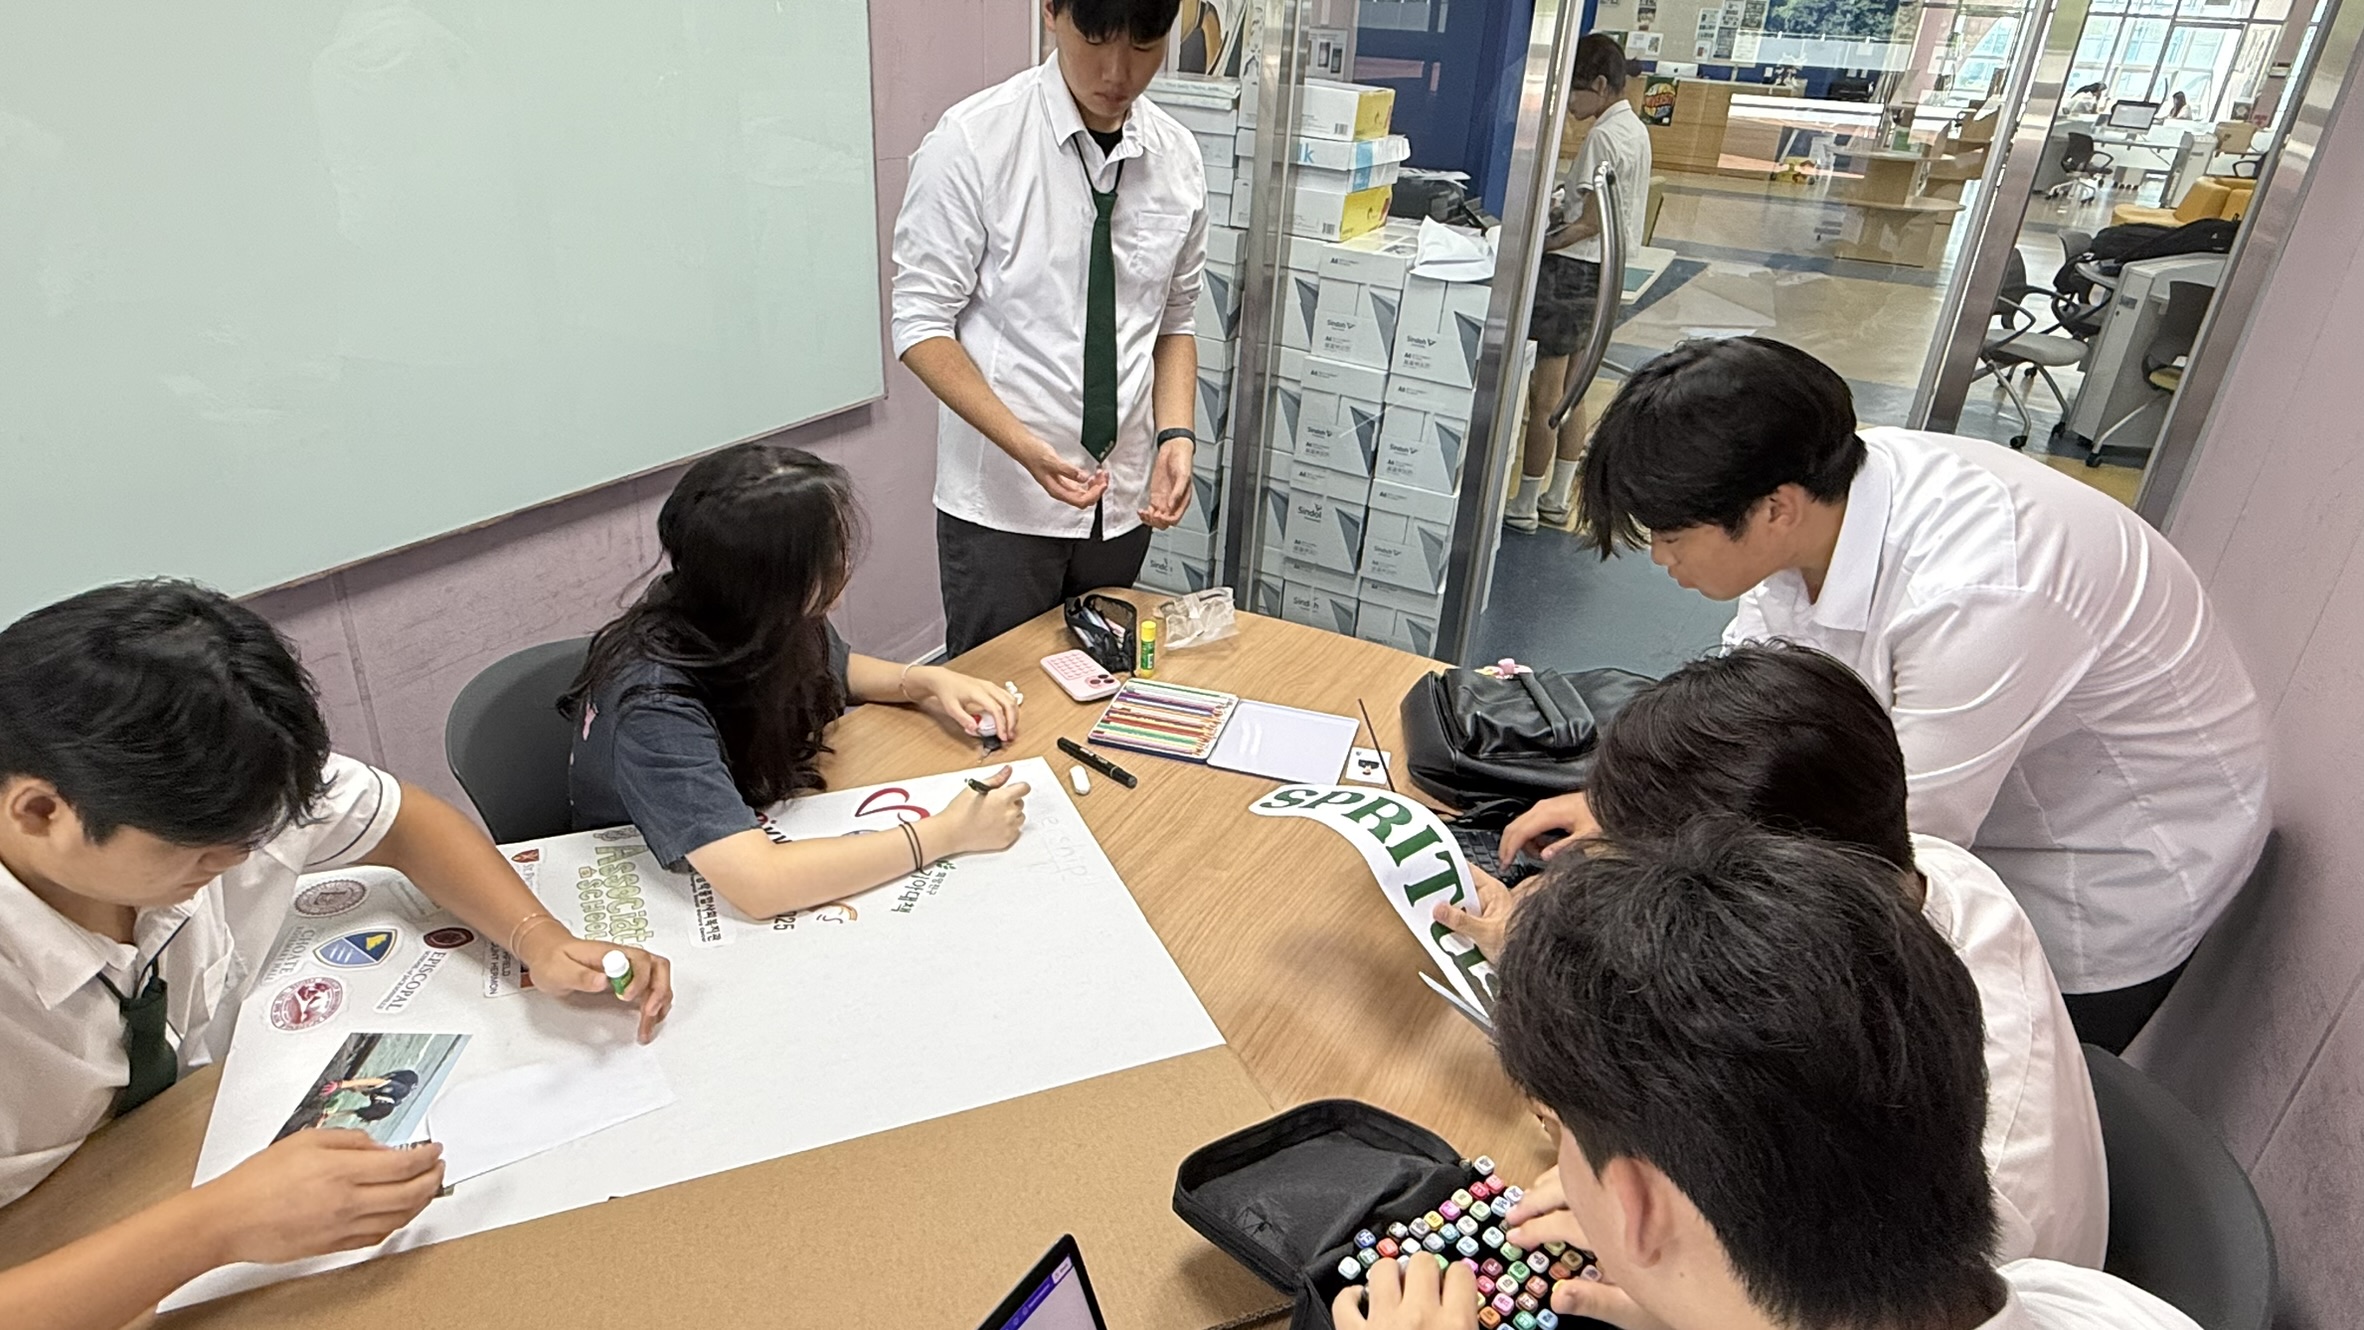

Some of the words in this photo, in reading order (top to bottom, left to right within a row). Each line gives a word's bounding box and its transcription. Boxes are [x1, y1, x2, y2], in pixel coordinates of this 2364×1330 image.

[1293, 596, 1319, 609] Sindh
[595, 844, 654, 949] Associat
[891, 868, 933, 914] 기아대책
[773, 911, 797, 931] 025
[280, 928, 315, 975] CHOATE
[385, 951, 446, 1011] EPISCOPAL
[489, 962, 499, 995] HERMON
